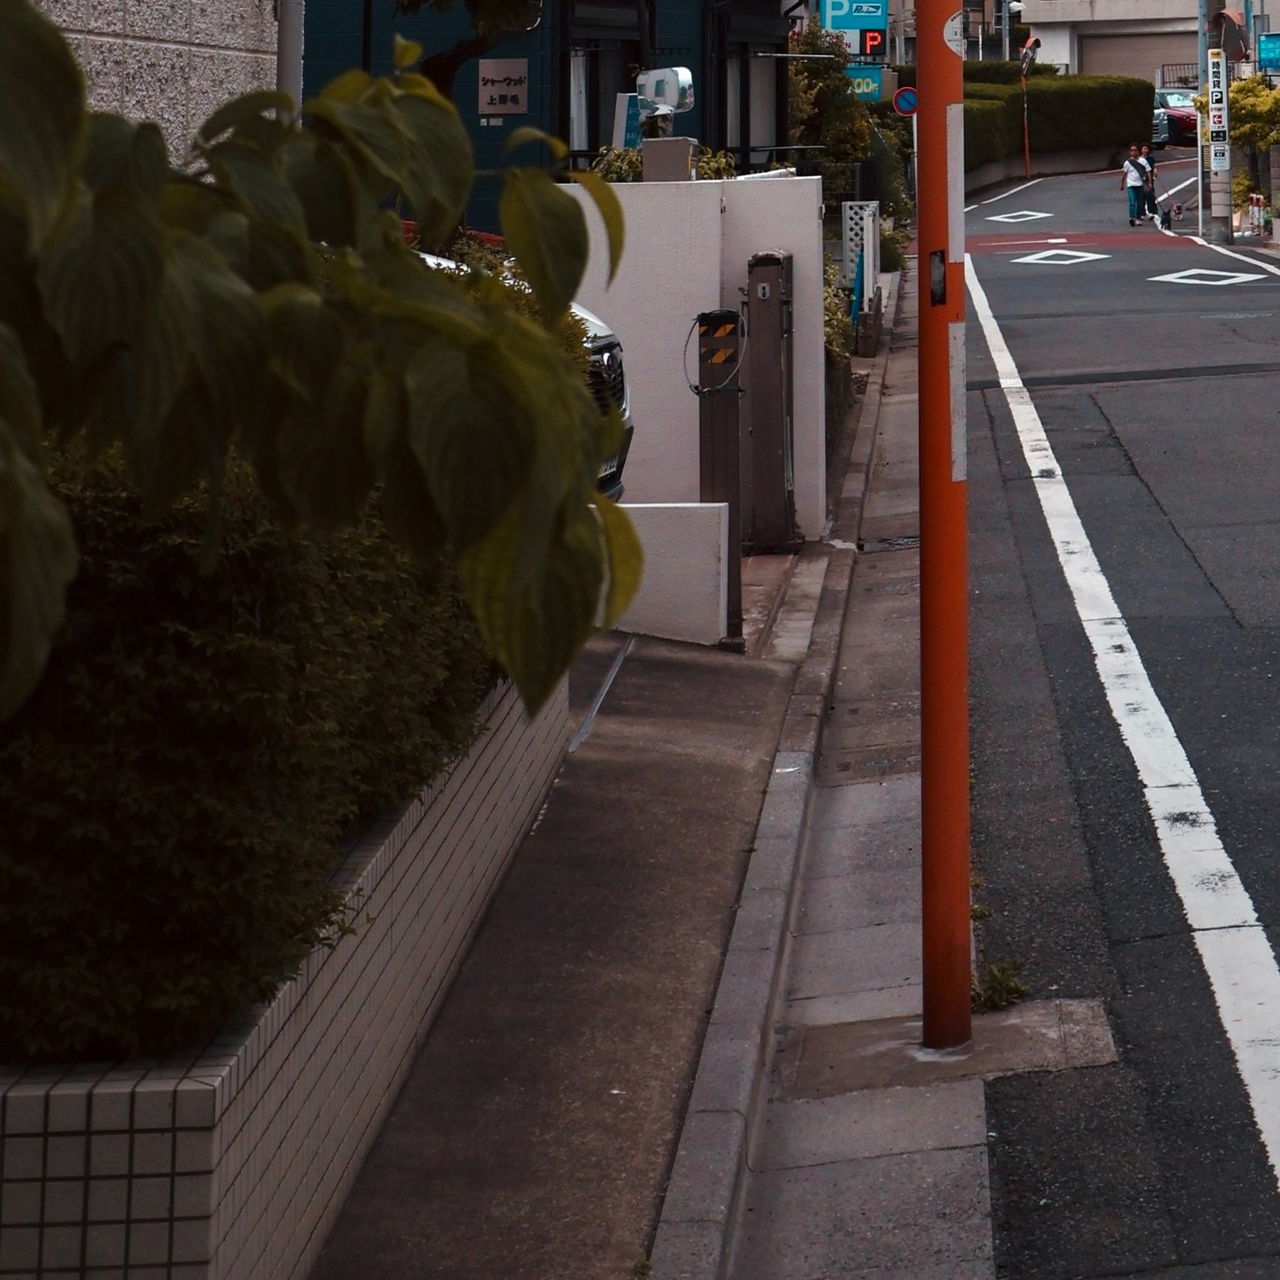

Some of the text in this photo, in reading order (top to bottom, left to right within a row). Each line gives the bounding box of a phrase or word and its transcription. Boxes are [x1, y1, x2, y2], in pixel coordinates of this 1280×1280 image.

[866, 32, 881, 54] P
[481, 76, 527, 87] シャーウッド
[1212, 92, 1222, 104] P
